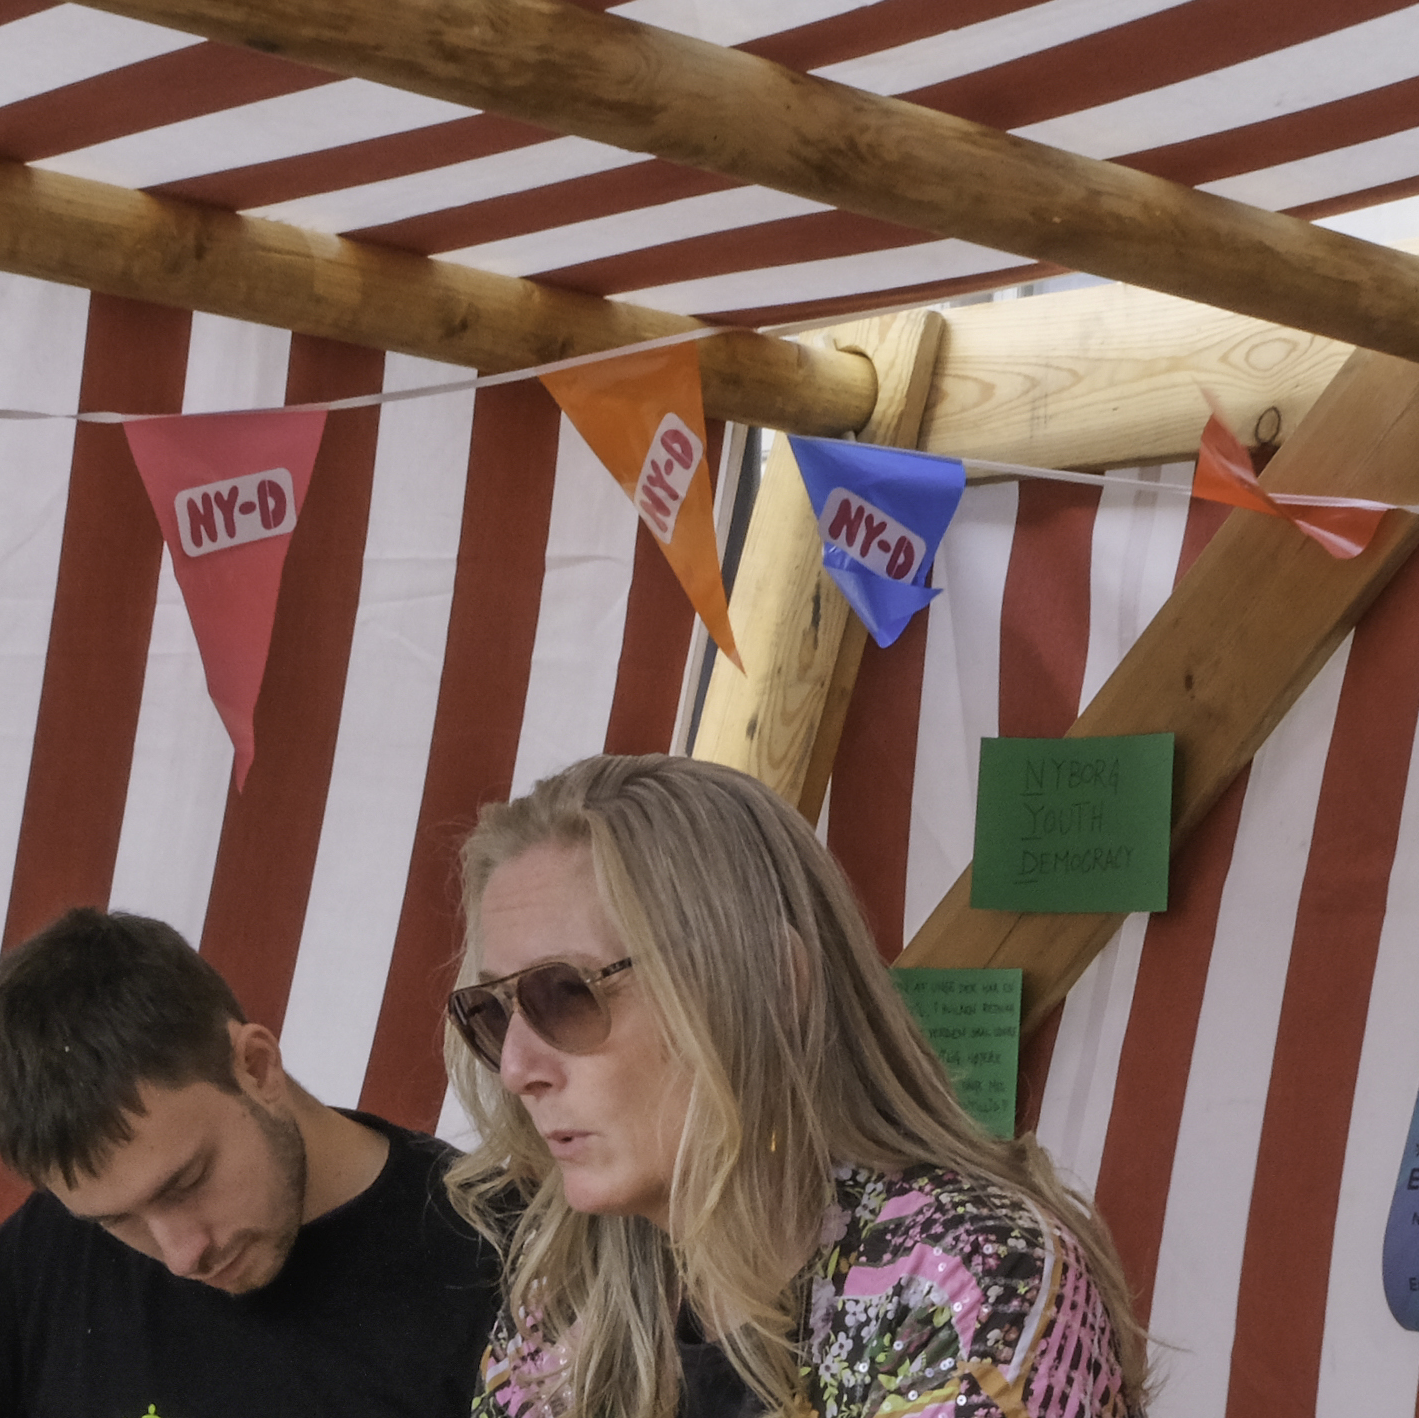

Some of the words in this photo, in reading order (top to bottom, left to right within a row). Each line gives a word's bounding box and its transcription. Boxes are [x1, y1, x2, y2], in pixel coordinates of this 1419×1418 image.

[186, 482, 286, 547] NY-D
[635, 427, 696, 534] NY-D
[828, 502, 915, 581] NY-D
